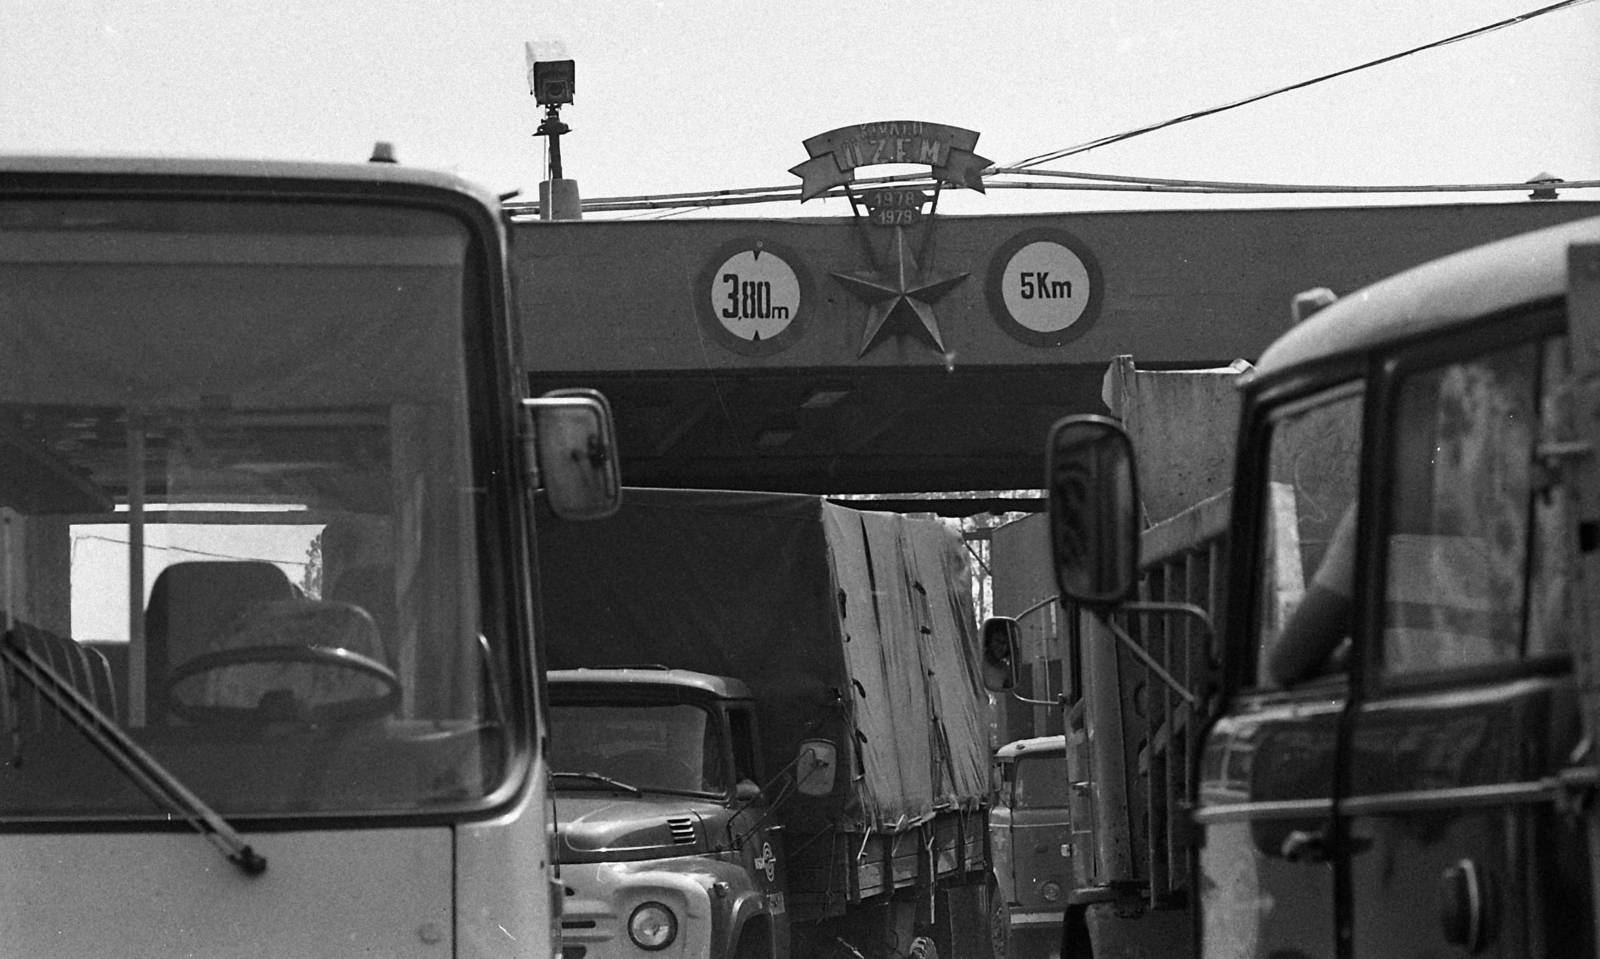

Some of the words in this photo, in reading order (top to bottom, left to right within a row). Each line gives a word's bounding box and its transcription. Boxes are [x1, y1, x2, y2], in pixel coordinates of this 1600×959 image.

[843, 138, 941, 168] ÜZEM
[875, 191, 914, 206] 1978
[879, 209, 912, 224] 1979
